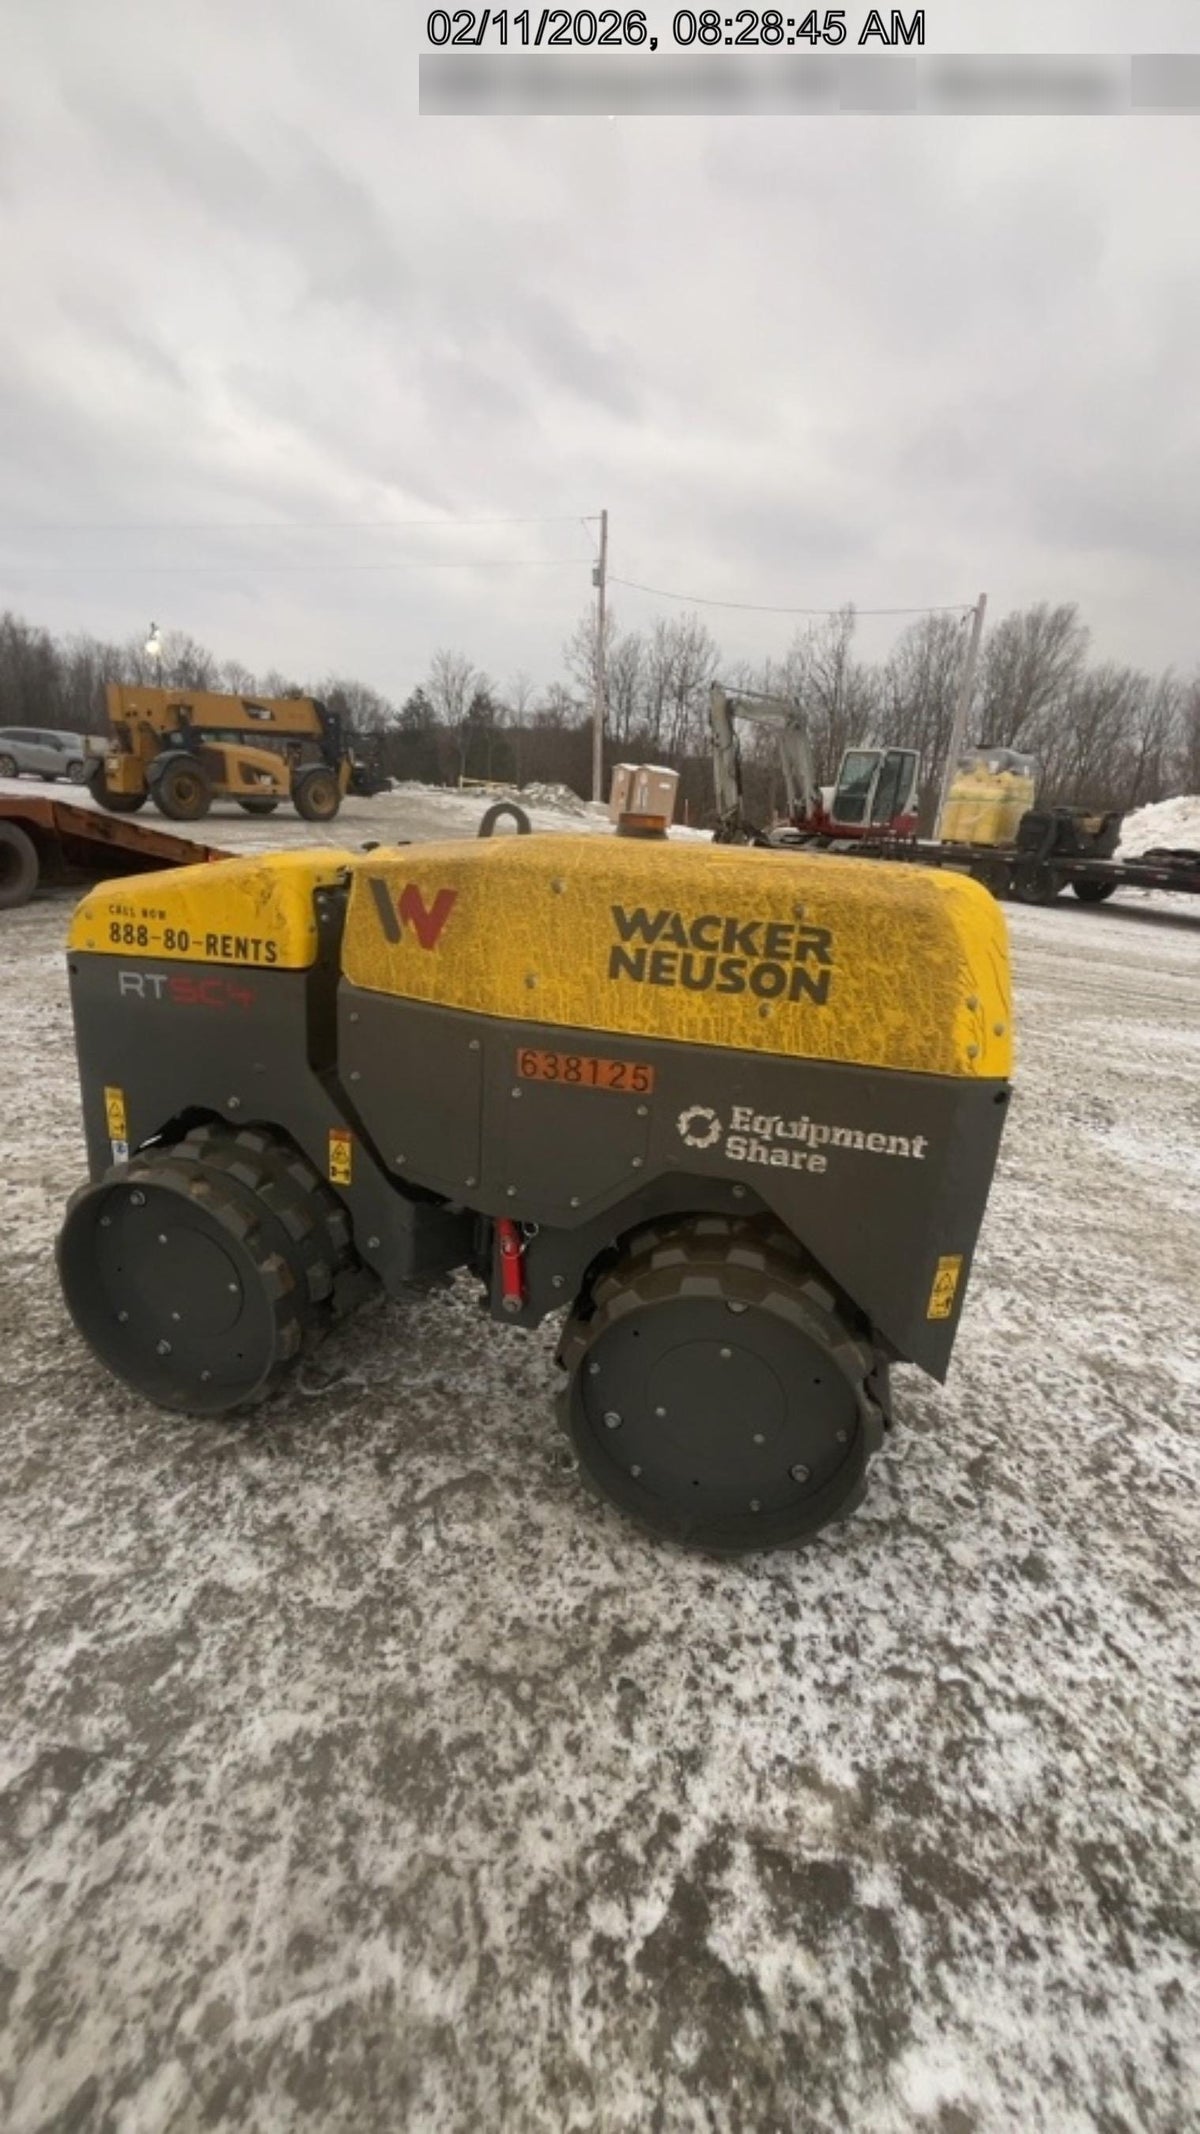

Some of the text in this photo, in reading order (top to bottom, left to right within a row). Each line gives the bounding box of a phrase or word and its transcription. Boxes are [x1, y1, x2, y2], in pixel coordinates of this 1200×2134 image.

[108, 904, 136, 918] CALL
[109, 922, 277, 963] 888-80-RENTS
[611, 905, 832, 965] WACKER
[609, 945, 831, 1006] NEUSON
[520, 1051, 649, 1092] 638125
[729, 1105, 928, 1159] Equipment
[725, 1135, 827, 1173] Share
